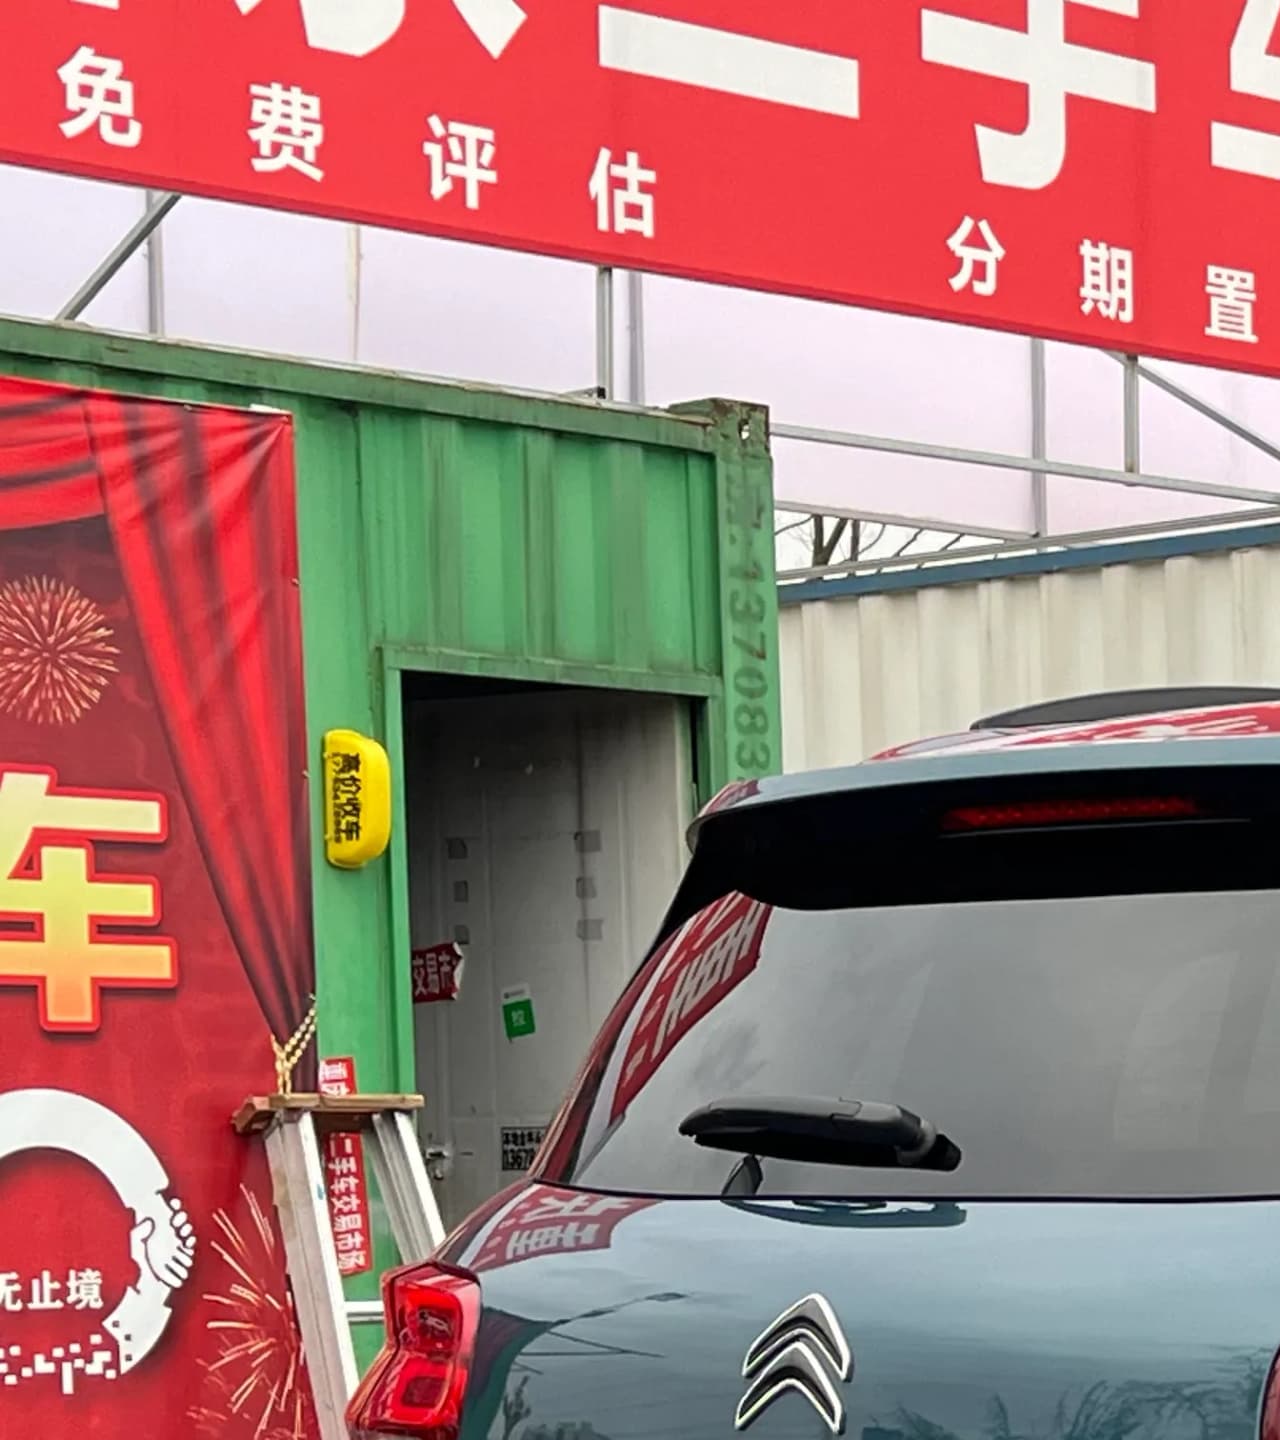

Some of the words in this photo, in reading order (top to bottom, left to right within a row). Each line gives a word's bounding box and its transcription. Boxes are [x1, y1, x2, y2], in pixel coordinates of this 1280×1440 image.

[56, 46, 657, 239] 免费评估
[728, 558, 771, 778] 137083
[338, 753, 362, 841] 高价收车
